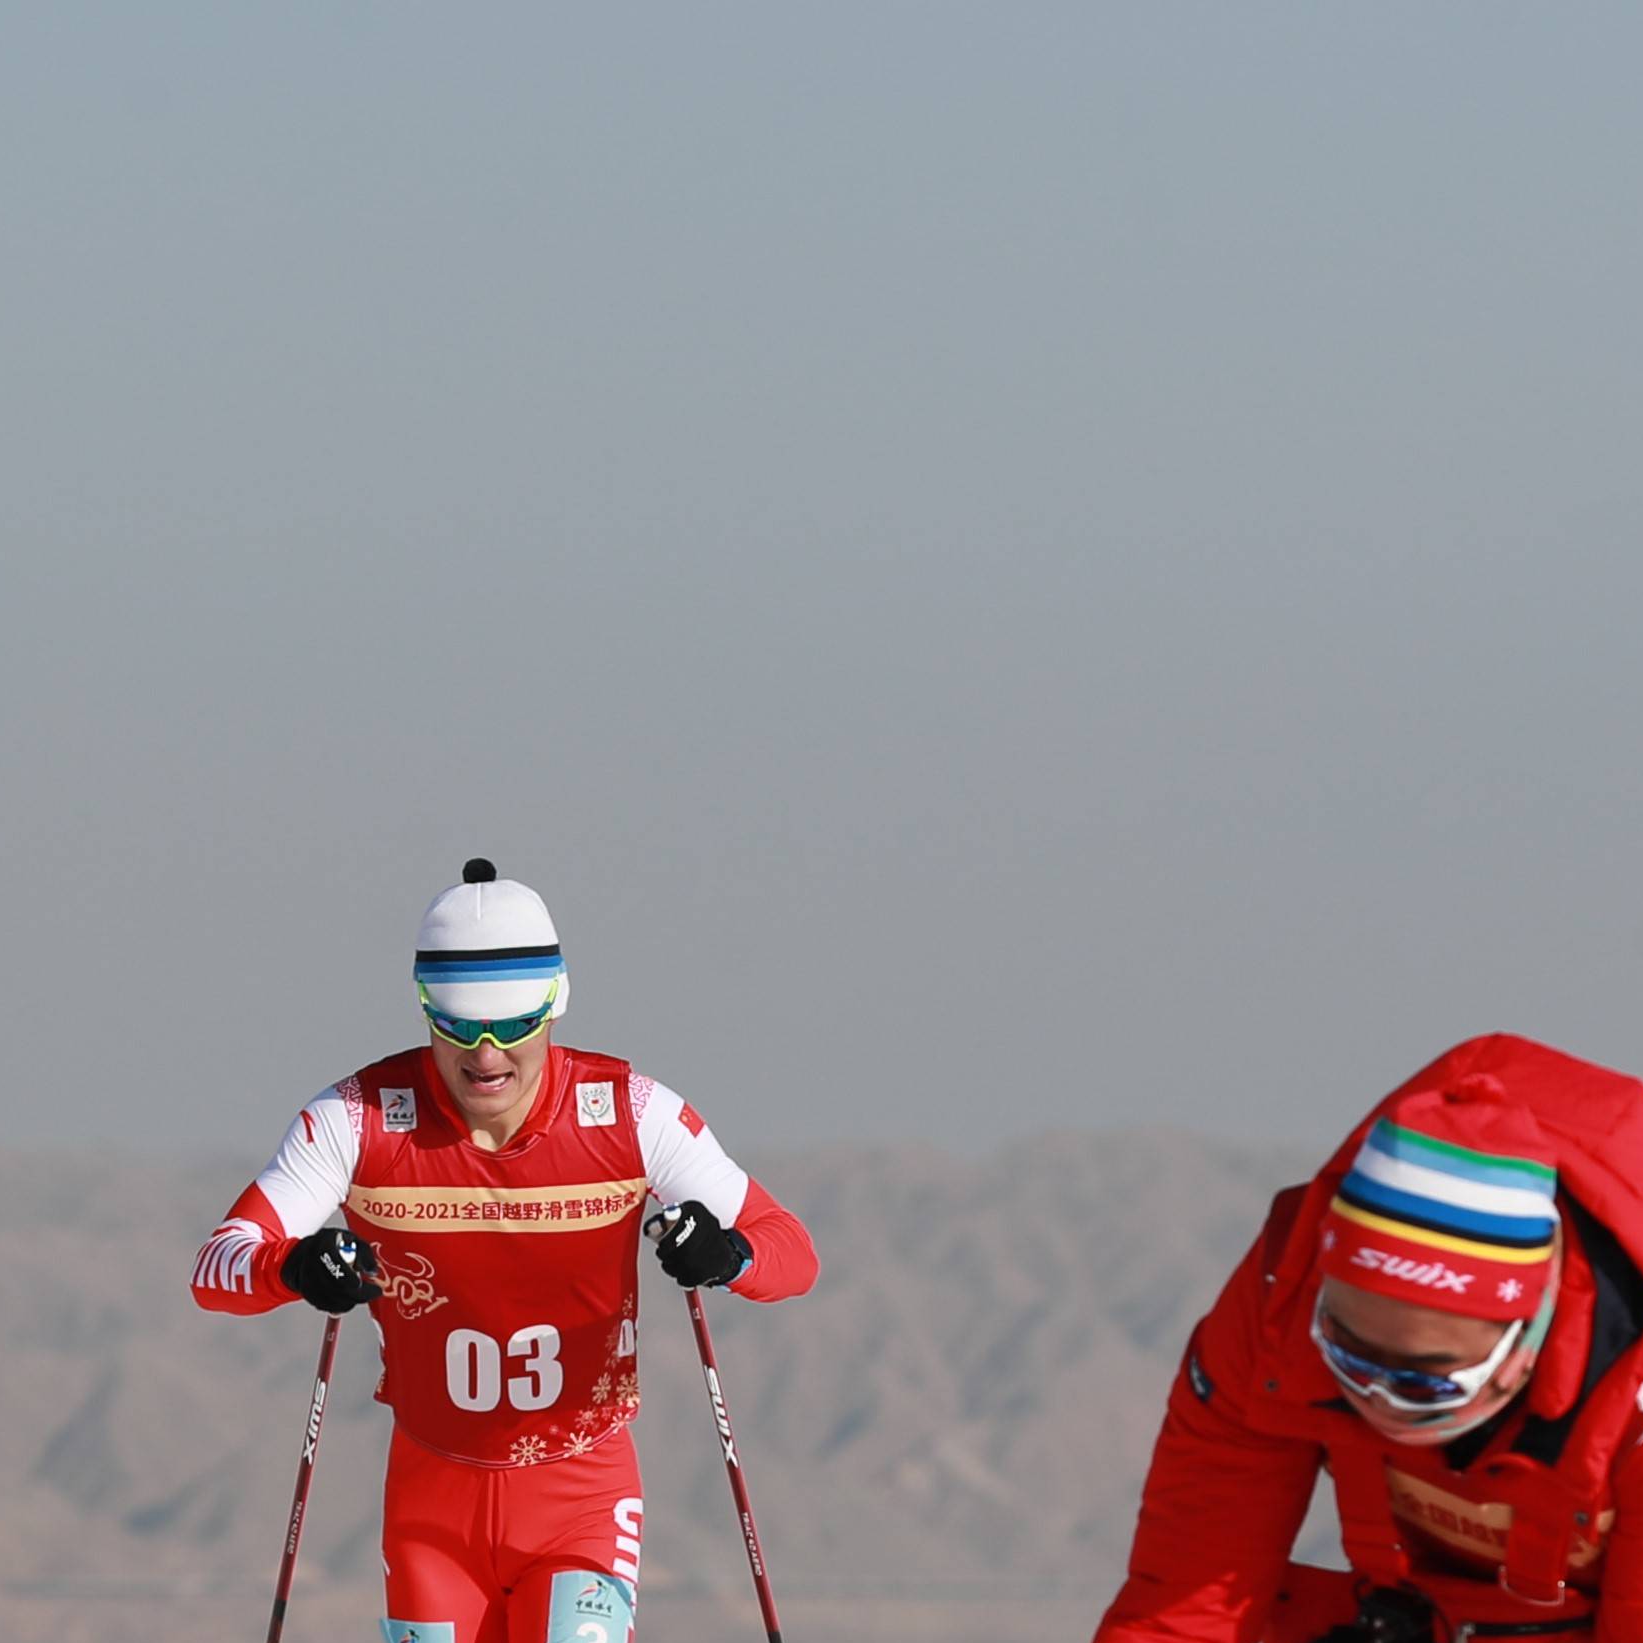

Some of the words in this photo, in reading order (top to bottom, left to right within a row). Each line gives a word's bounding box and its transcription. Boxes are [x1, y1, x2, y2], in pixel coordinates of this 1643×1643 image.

[446, 1324, 563, 1412] 03
[303, 1377, 326, 1465] SWIX
[704, 1365, 739, 1468] SWIX
